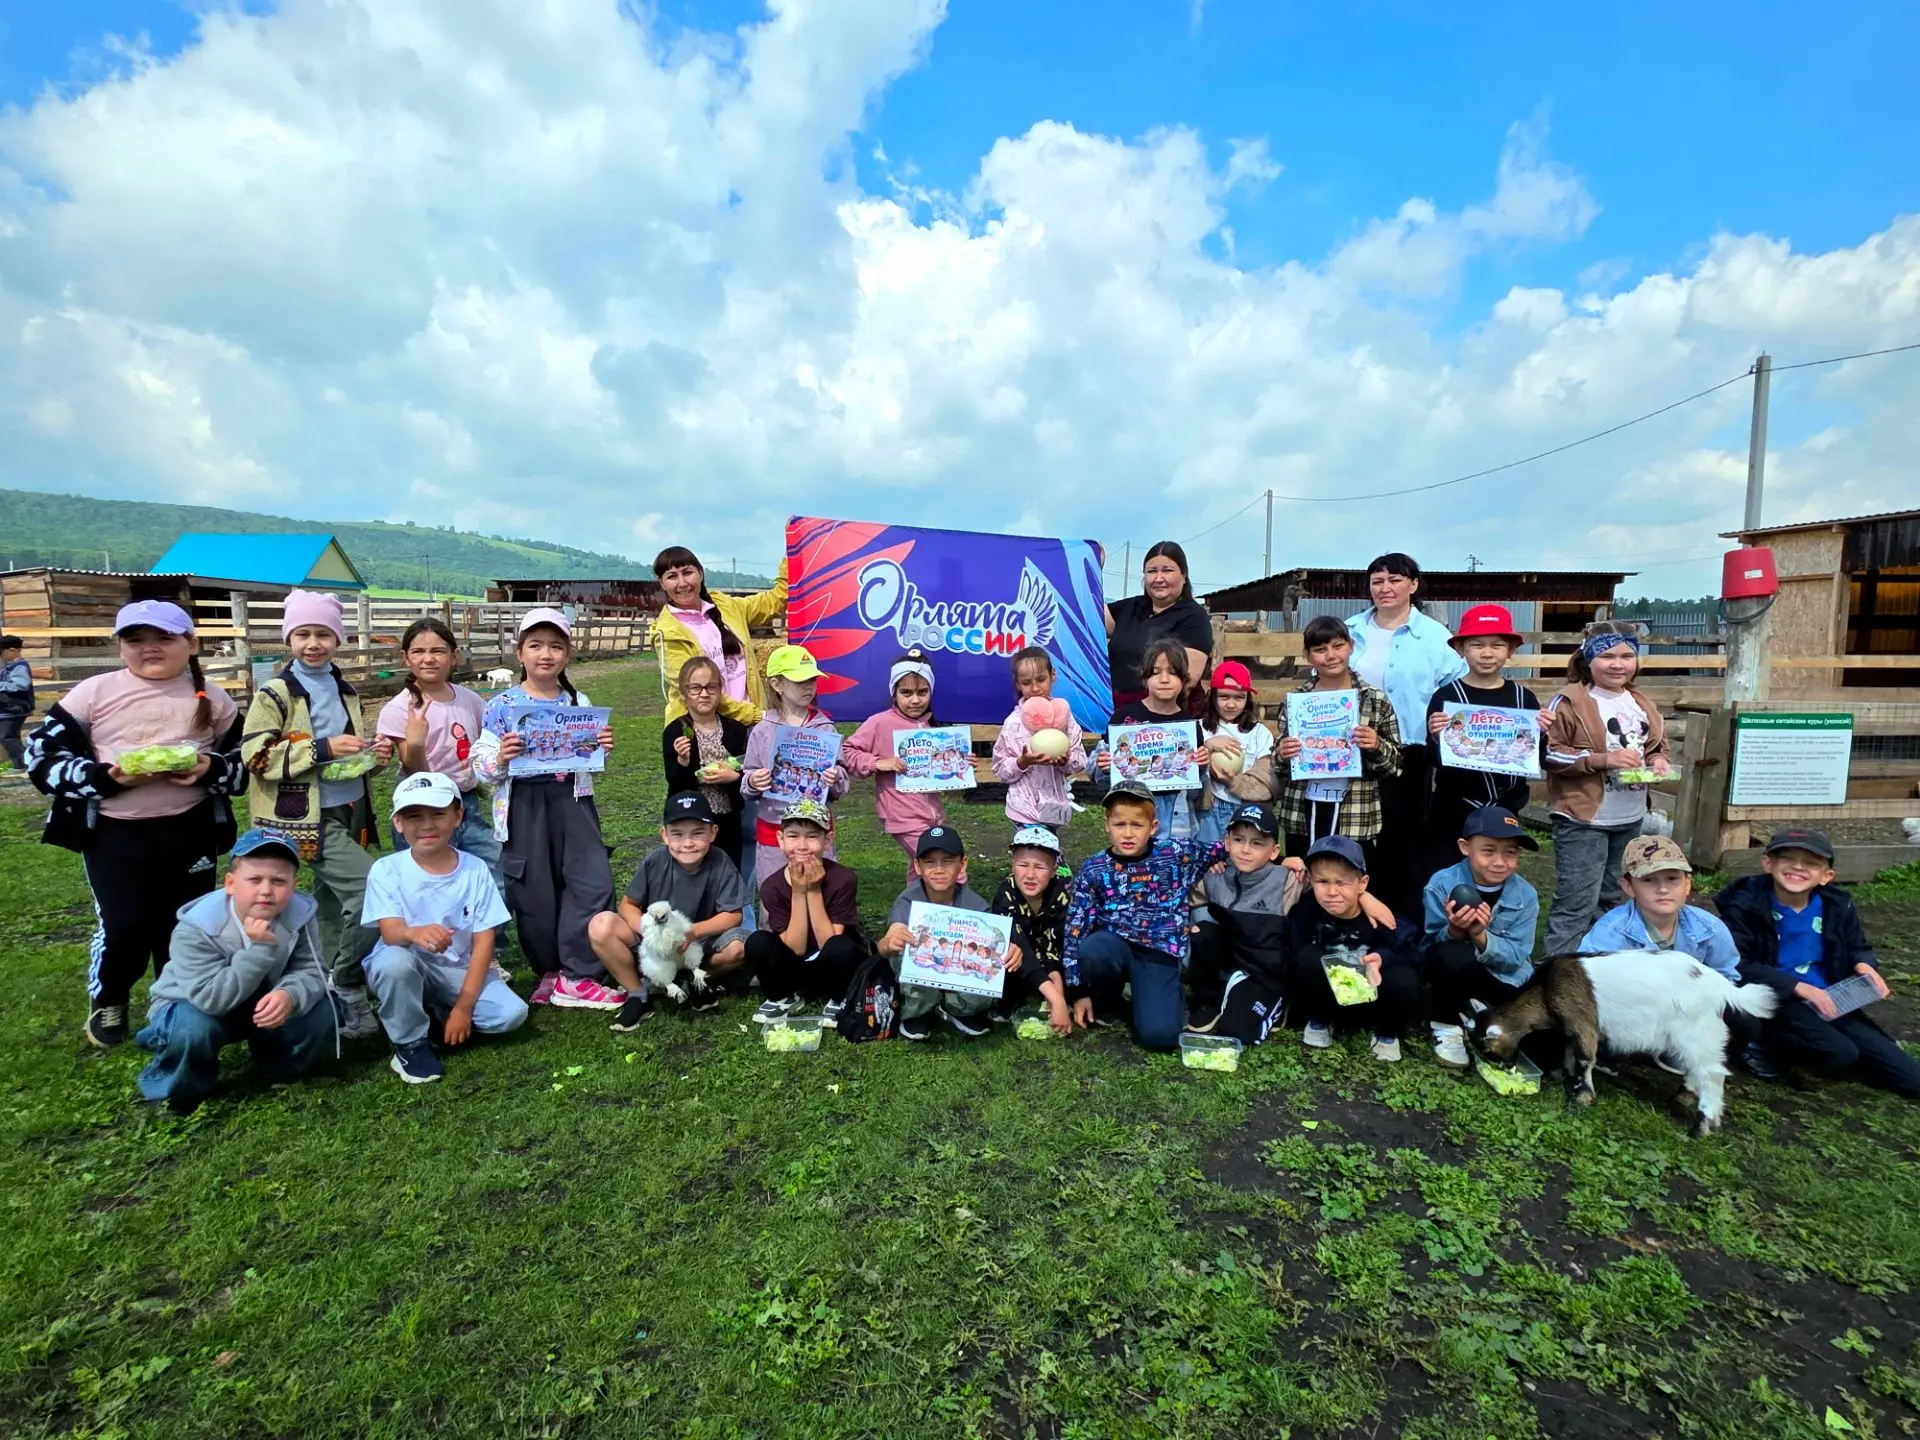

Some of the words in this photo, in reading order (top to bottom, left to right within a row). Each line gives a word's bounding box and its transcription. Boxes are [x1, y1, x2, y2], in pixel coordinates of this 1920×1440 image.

[860, 560, 1027, 635] Орлята
[902, 626, 1025, 654] РОССИИ
[1472, 724, 1501, 732] время
[1137, 741, 1164, 750] время
